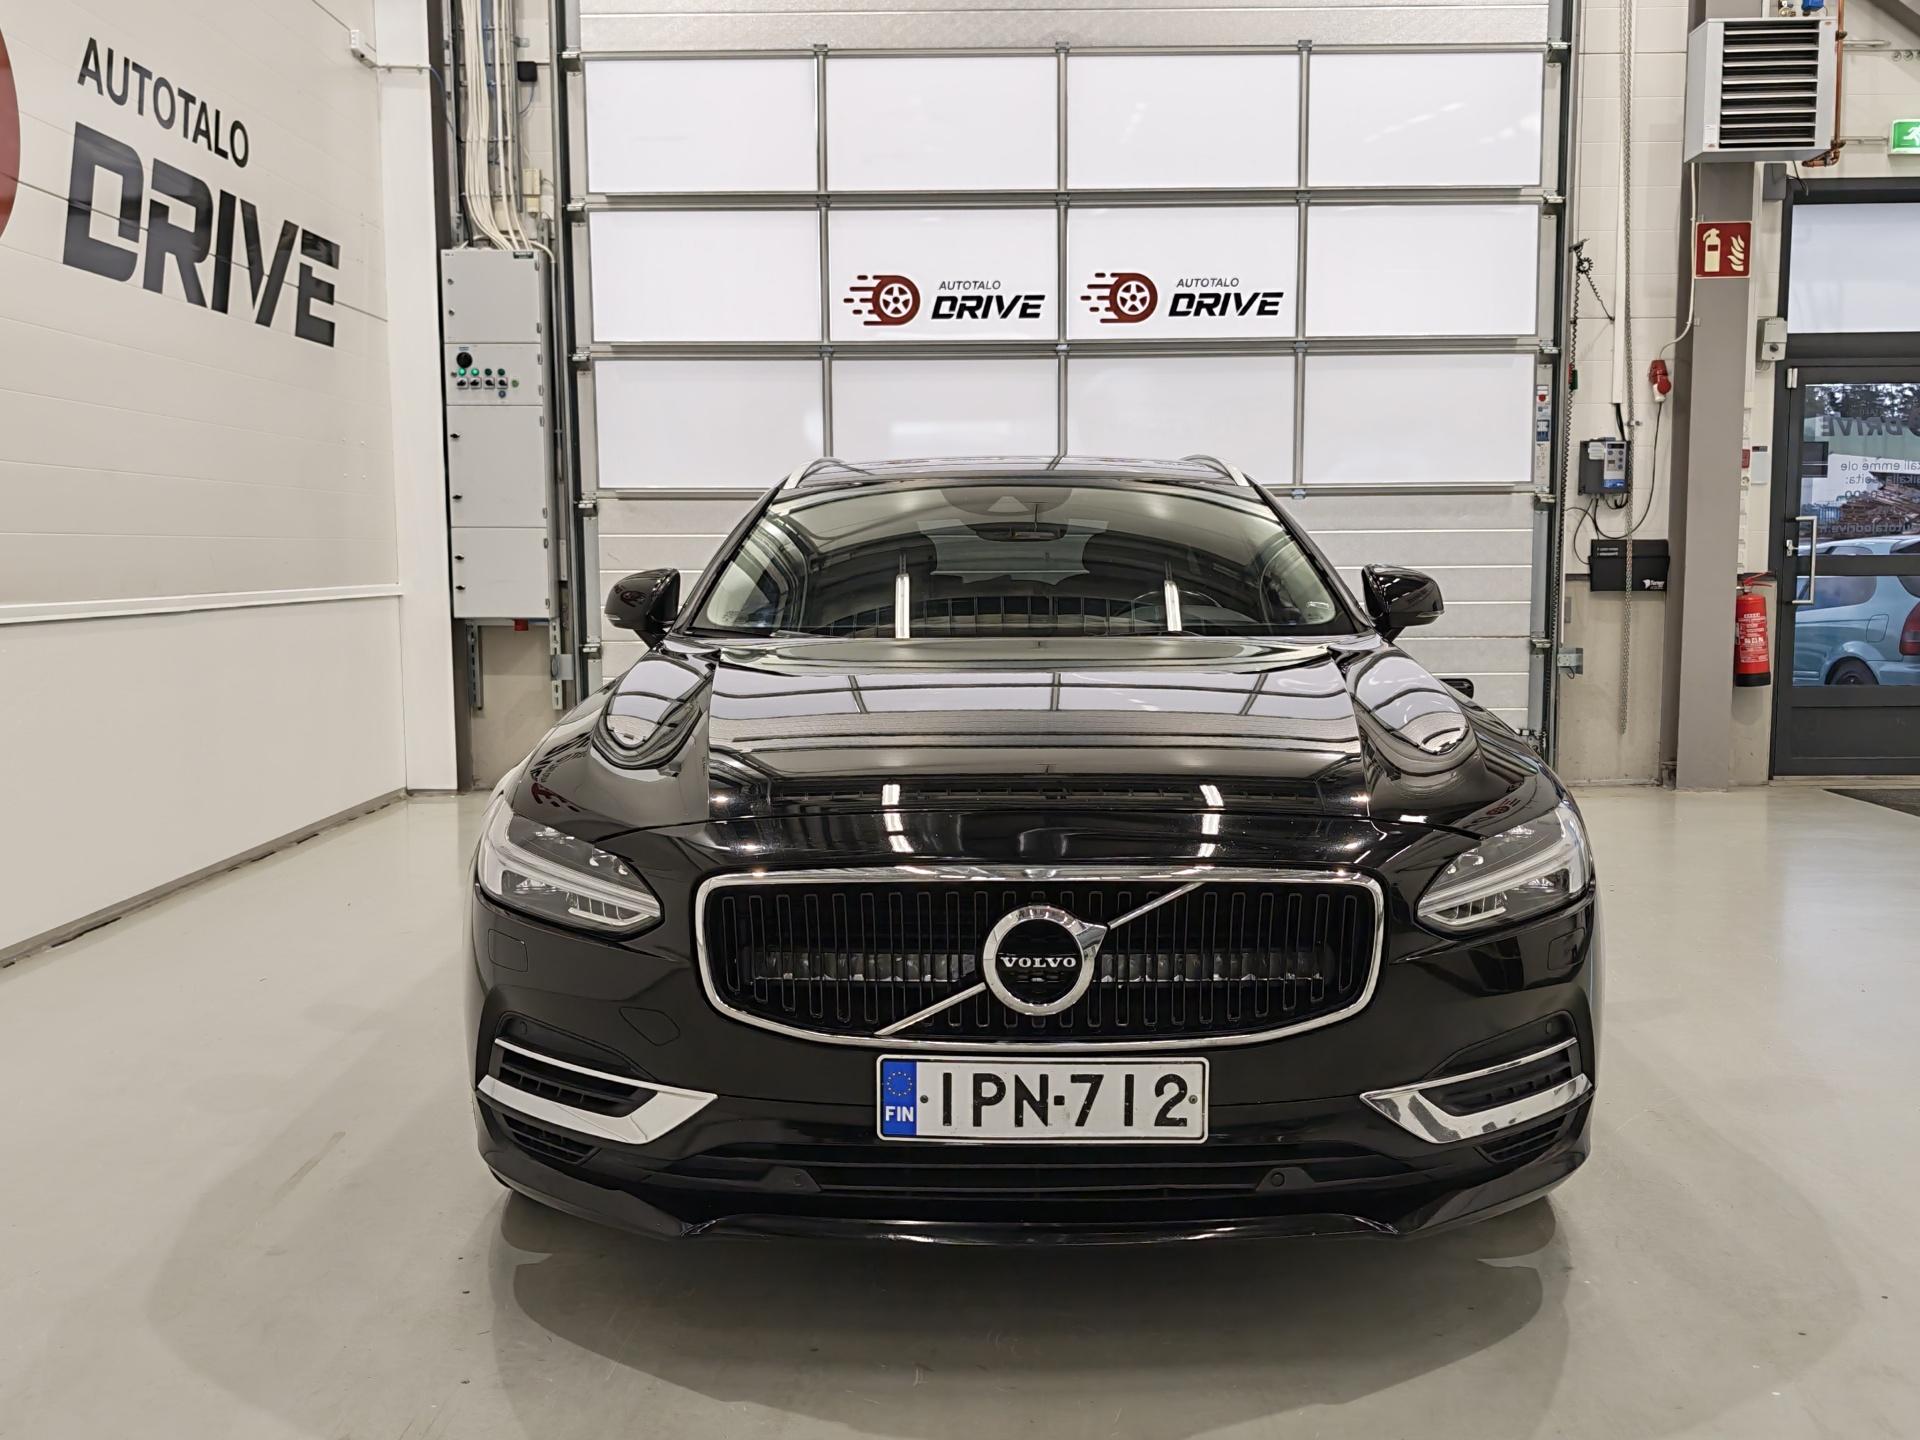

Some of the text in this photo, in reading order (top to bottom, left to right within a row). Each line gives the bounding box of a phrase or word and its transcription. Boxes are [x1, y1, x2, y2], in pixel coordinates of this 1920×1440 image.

[77, 37, 249, 168] AUTOTALO
[63, 121, 341, 347] DRIVE
[938, 280, 1002, 291] AUTOTALO
[1176, 278, 1239, 288] AUTOTALO
[931, 295, 1046, 319] DRIVE
[1168, 292, 1284, 317] DRIVE
[1000, 957, 1076, 968] VOLVO
[942, 1073, 1188, 1127] IPN-712
[885, 1106, 914, 1122] FIN
